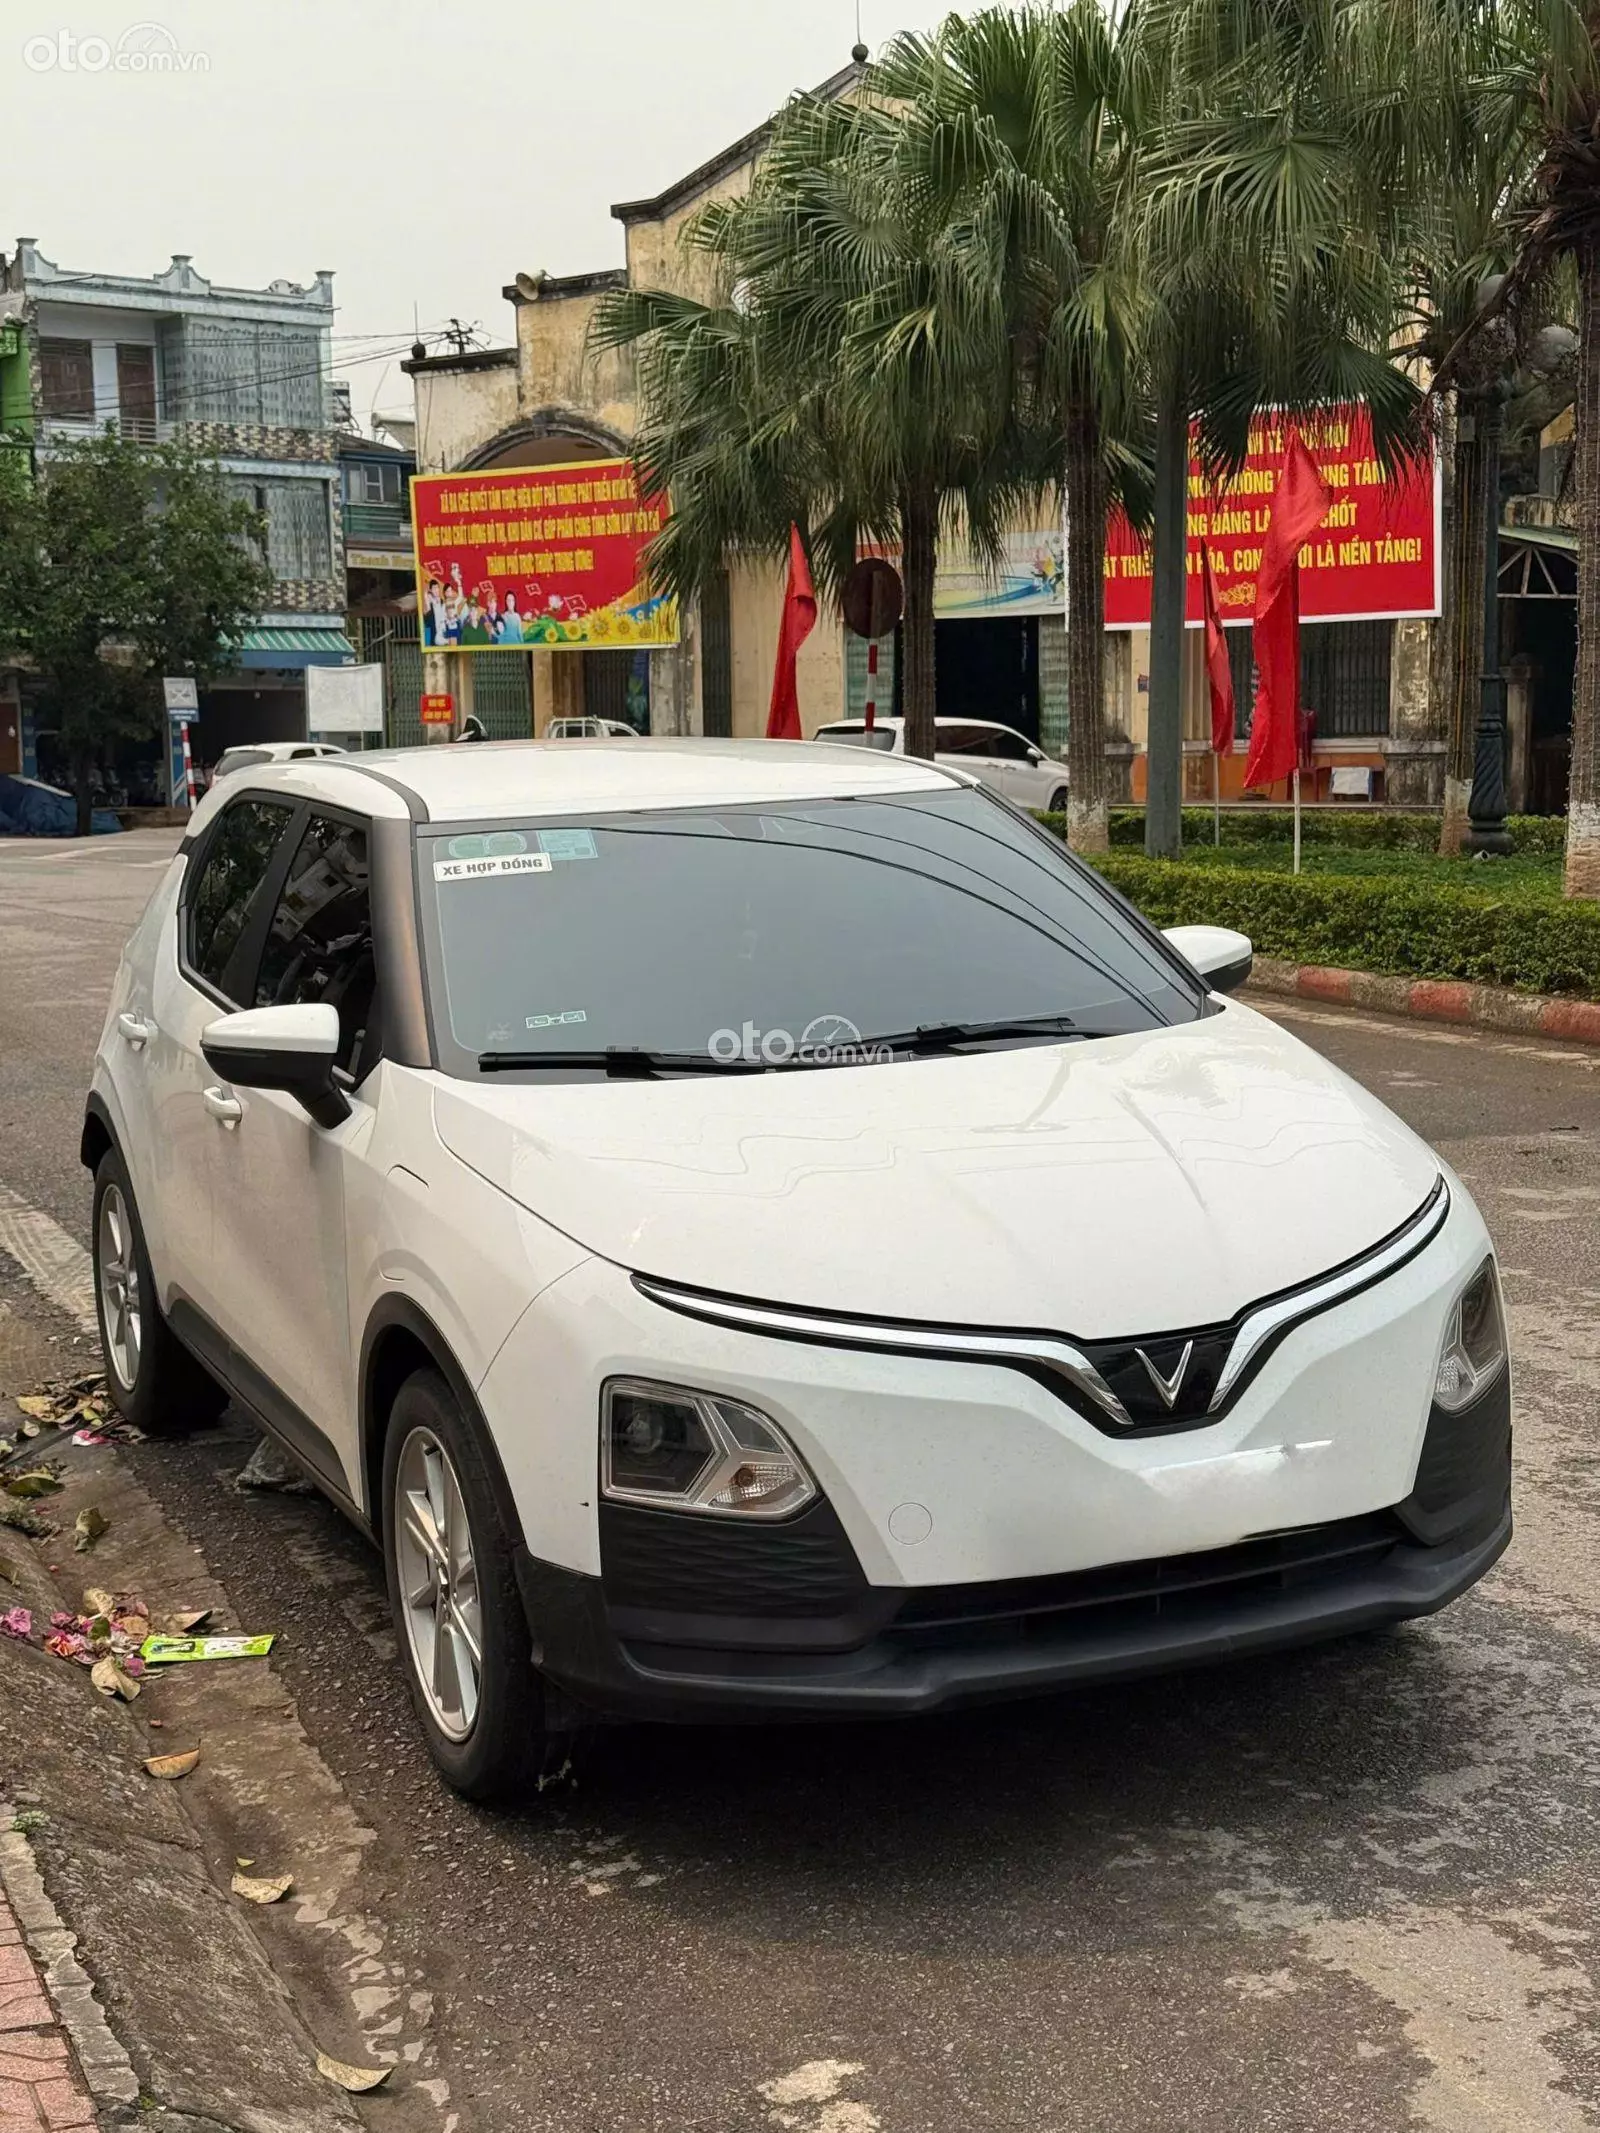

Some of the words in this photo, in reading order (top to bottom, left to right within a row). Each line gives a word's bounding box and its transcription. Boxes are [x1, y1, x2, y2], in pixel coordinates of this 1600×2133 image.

[1316, 540, 1335, 567] LÀ
[1338, 535, 1371, 566] NỀN
[1374, 532, 1421, 564] TẢNG!
[442, 866, 462, 876] XE
[466, 861, 496, 874] HỢP
